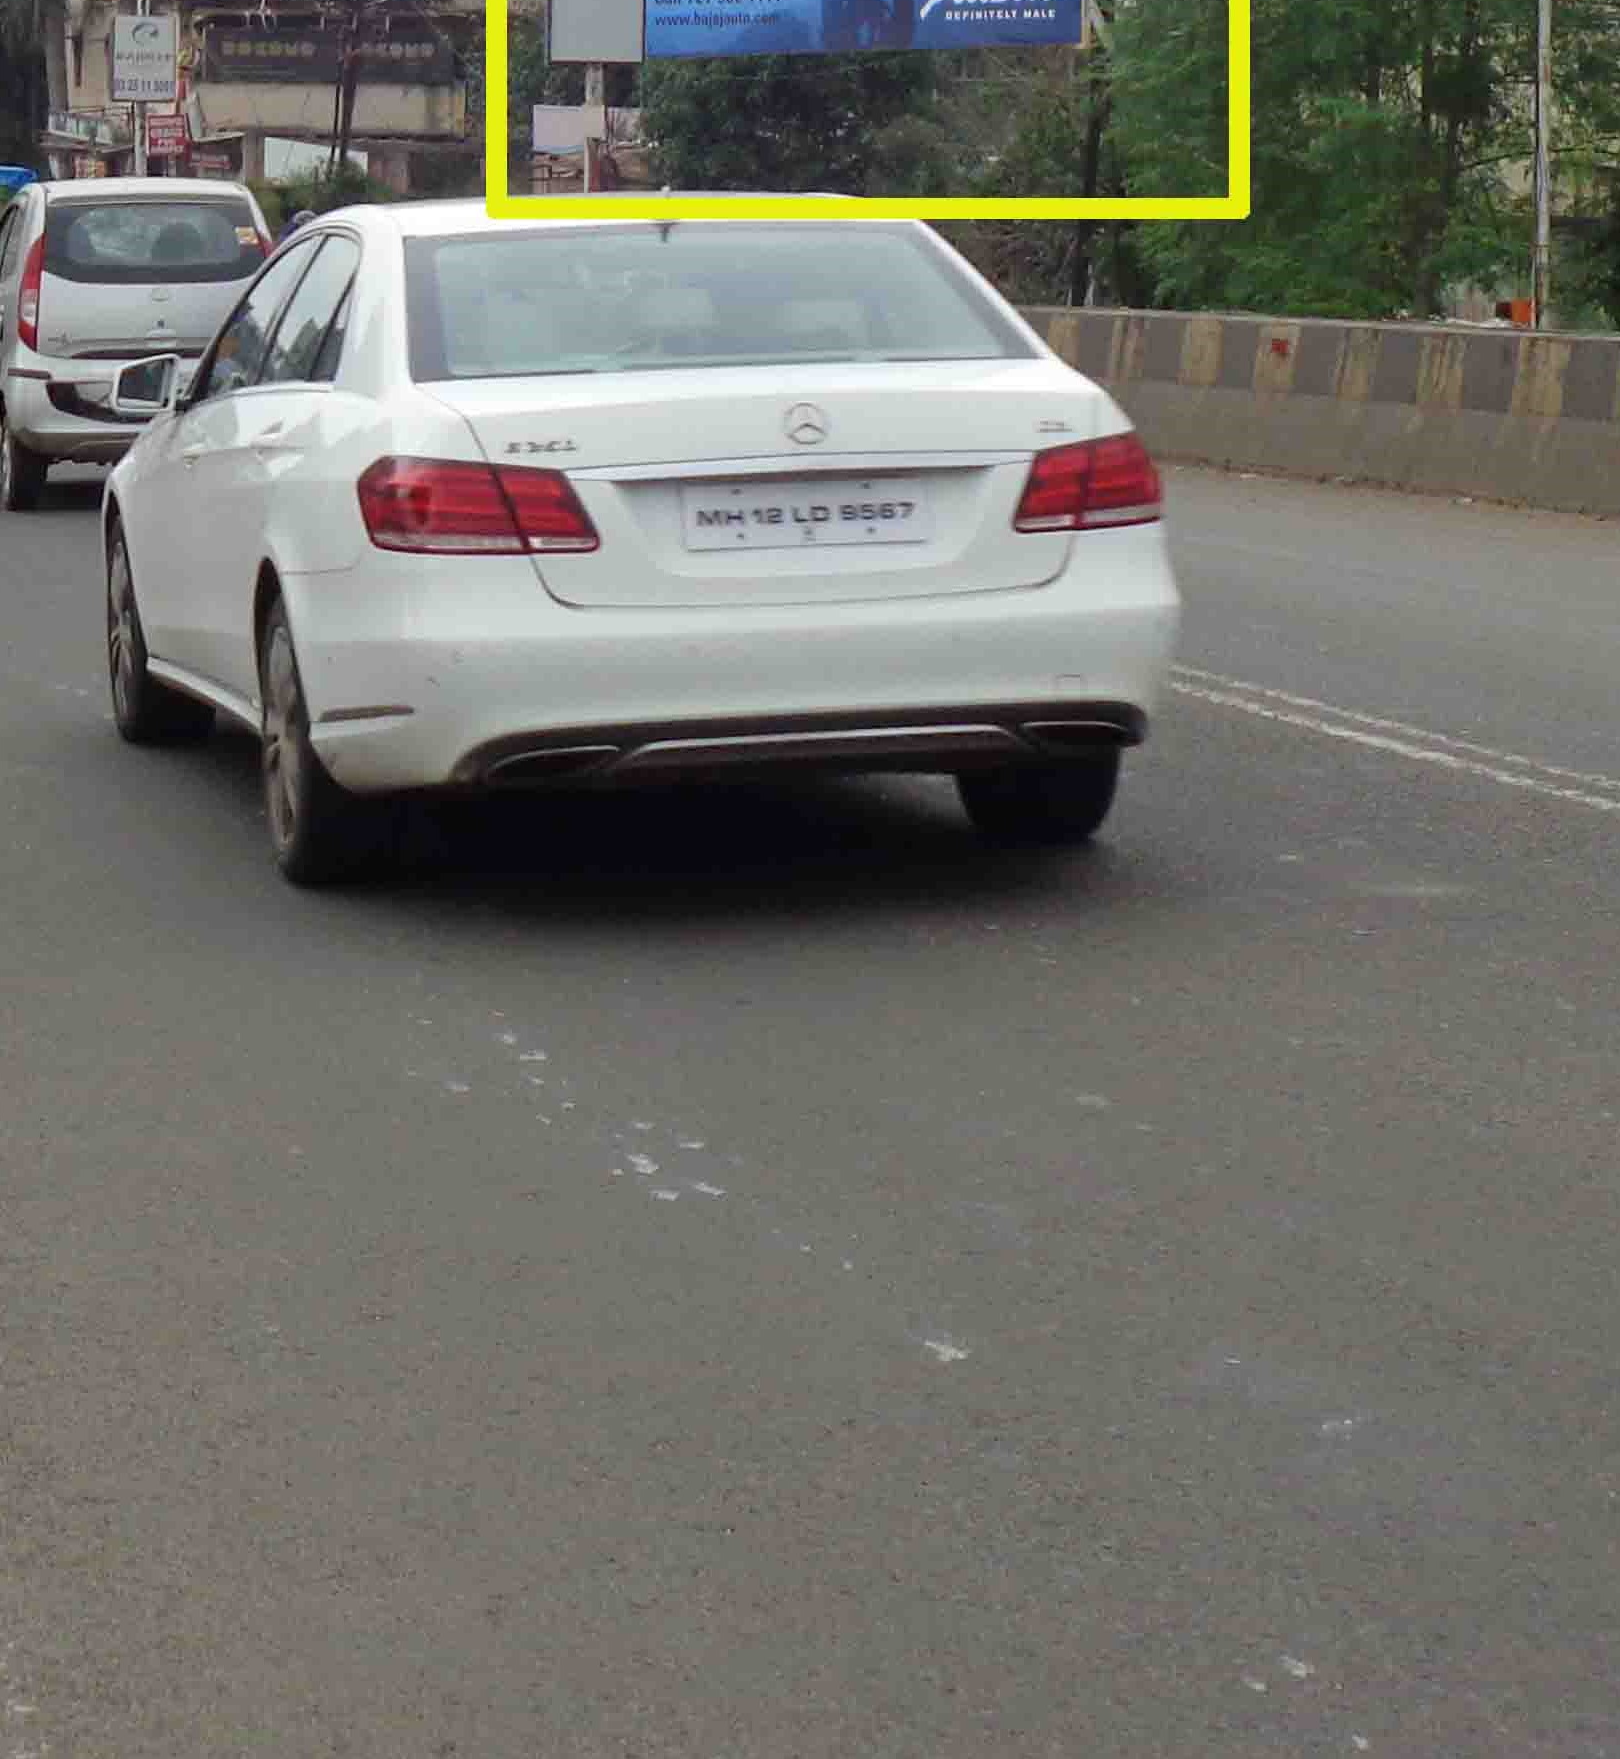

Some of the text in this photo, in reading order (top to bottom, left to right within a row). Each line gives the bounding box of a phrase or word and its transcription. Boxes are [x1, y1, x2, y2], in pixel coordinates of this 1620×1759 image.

[945, 8, 1056, 20] DEFINITELY MALE
[696, 509, 745, 526] MH
[751, 507, 784, 524] 12
[792, 505, 830, 522] LD
